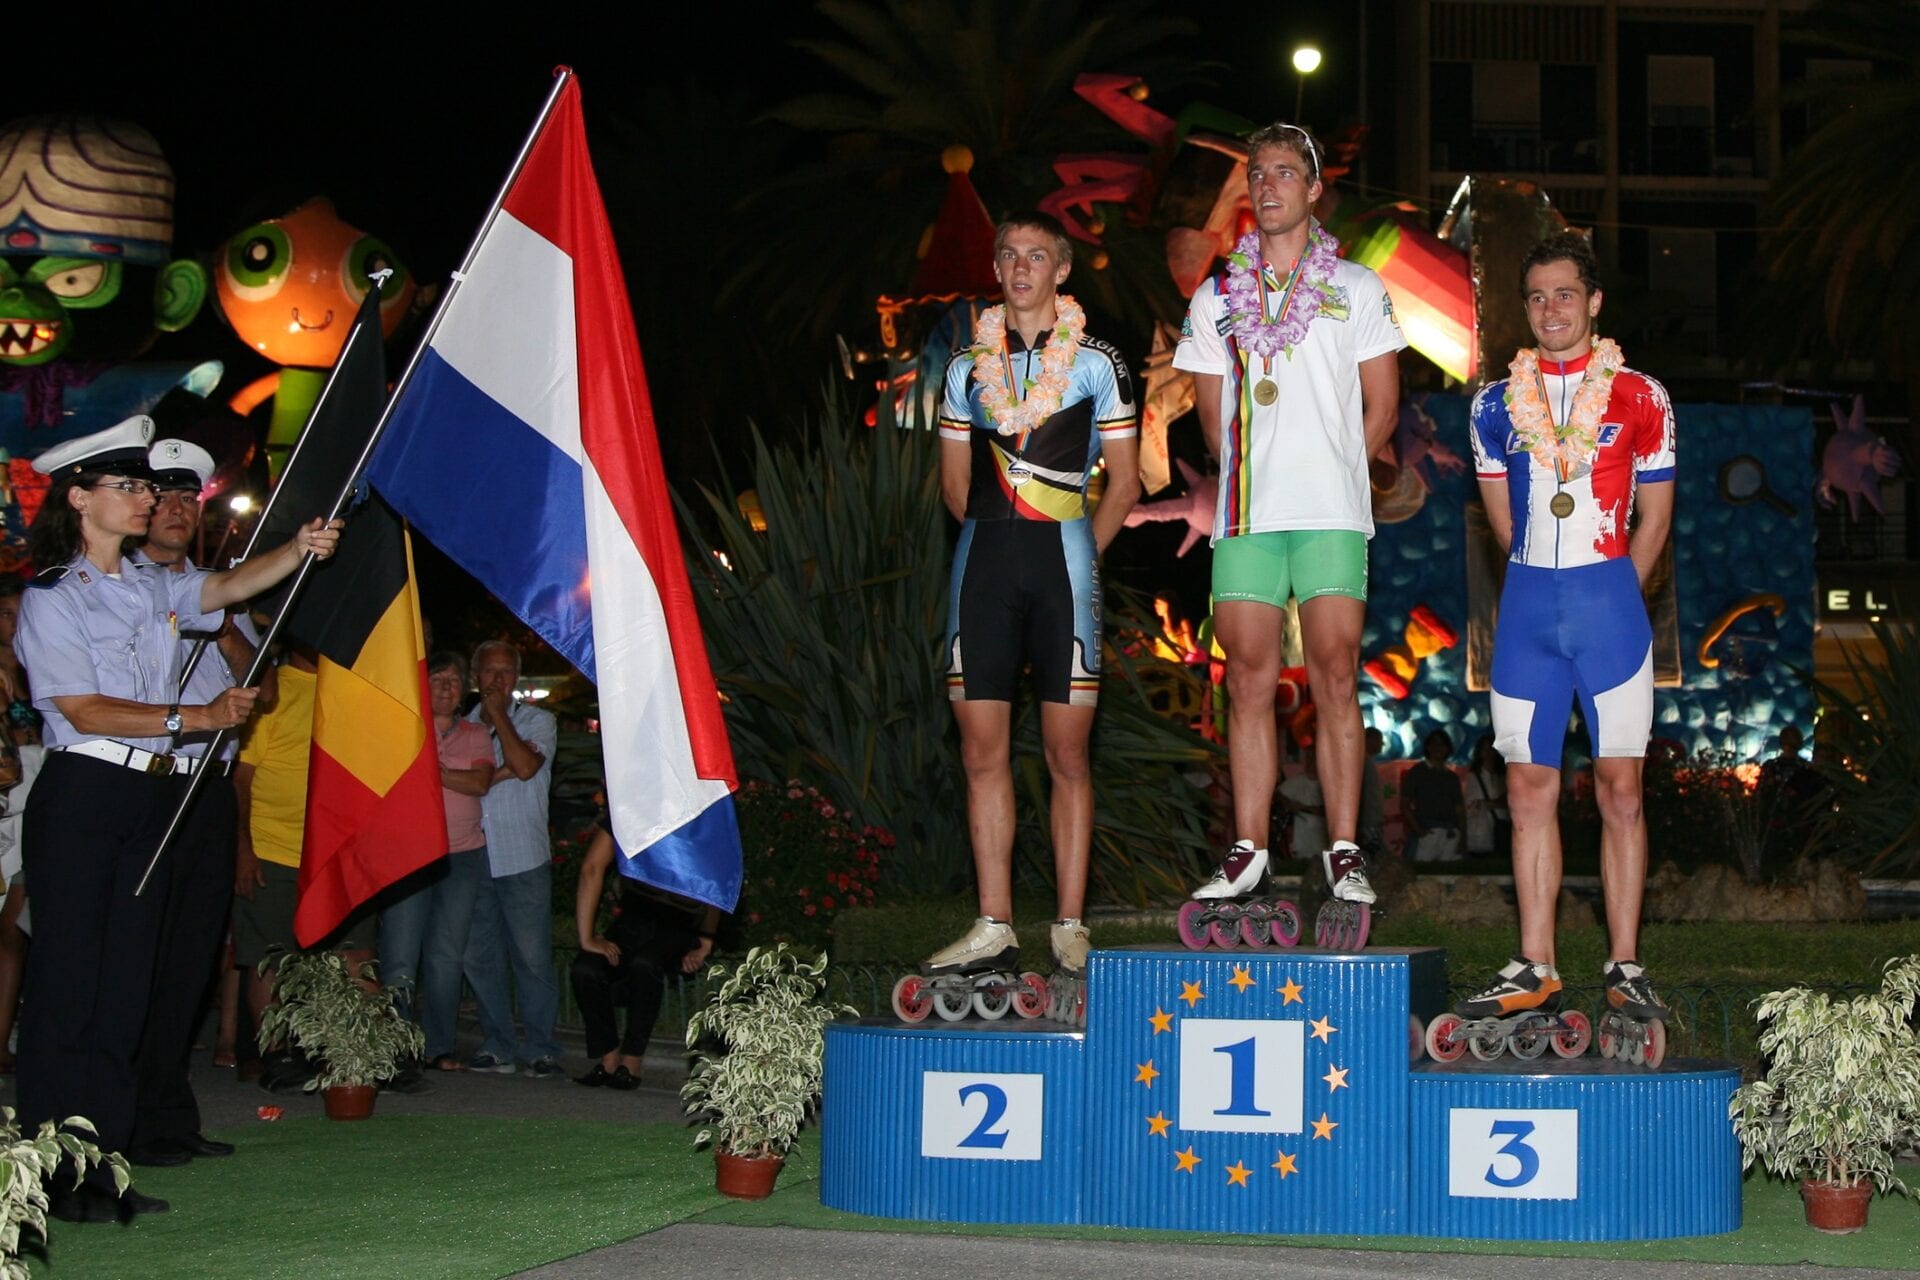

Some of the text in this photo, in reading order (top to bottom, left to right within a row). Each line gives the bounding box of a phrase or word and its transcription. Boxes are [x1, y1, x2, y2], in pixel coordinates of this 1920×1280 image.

[1079, 336, 1127, 379] ELGIUM
[1214, 1037, 1271, 1116] 1
[958, 1084, 1009, 1149] 2
[1485, 1120, 1539, 1187] 3
